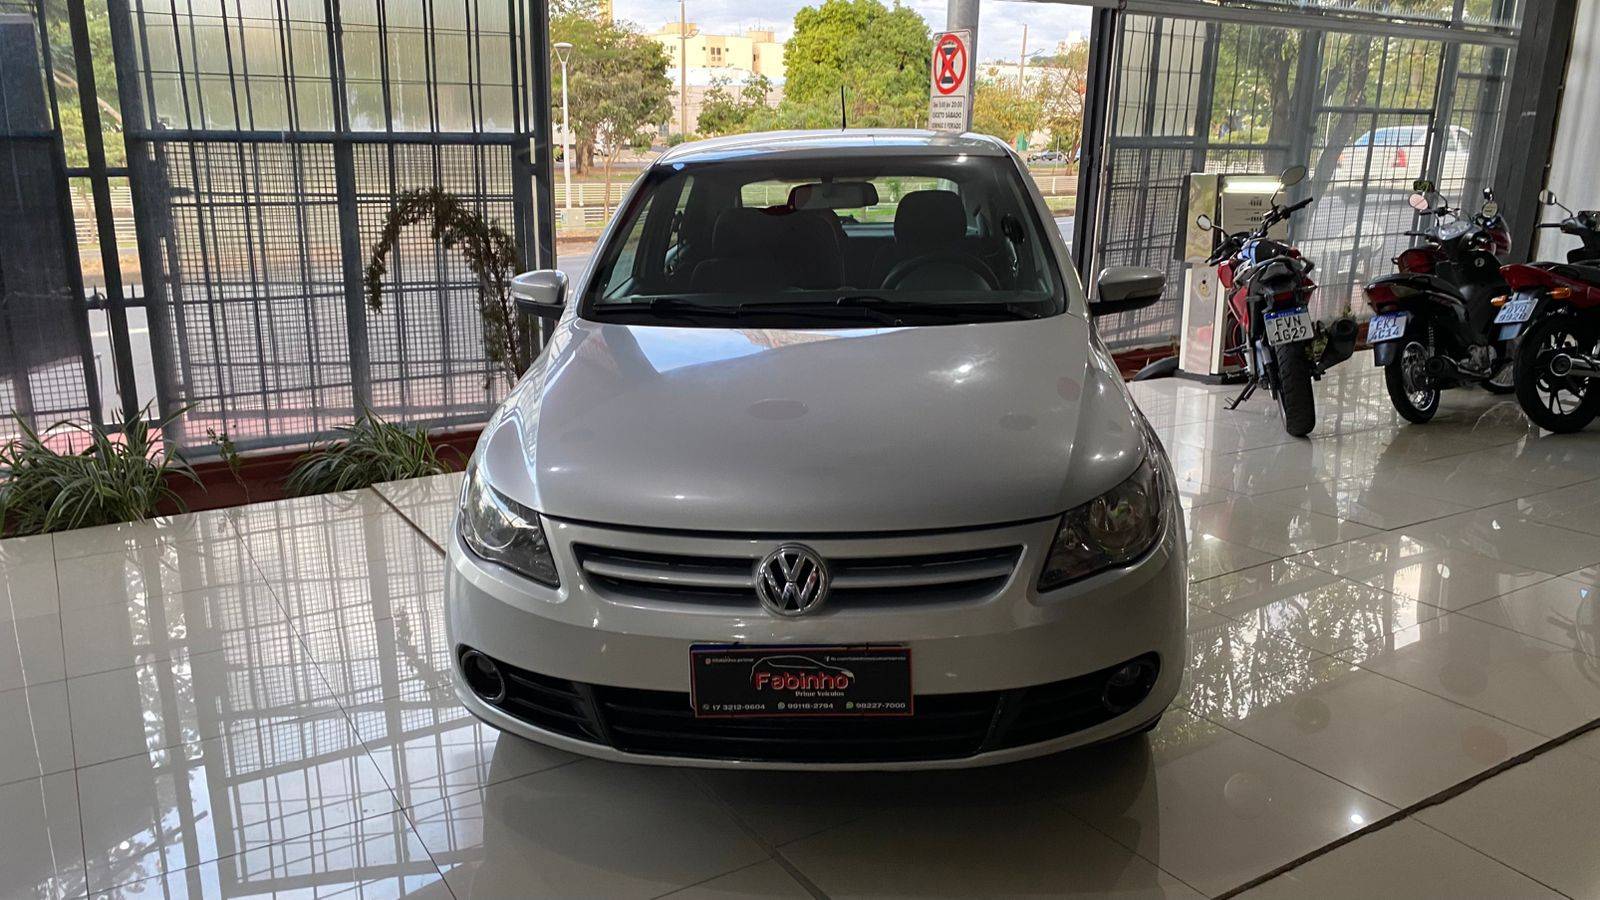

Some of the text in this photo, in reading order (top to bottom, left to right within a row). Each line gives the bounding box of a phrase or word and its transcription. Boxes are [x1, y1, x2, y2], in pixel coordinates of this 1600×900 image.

[1275, 315, 1302, 330] FVN
[1274, 326, 1307, 342] 1G29
[755, 670, 849, 691] Fabinho
